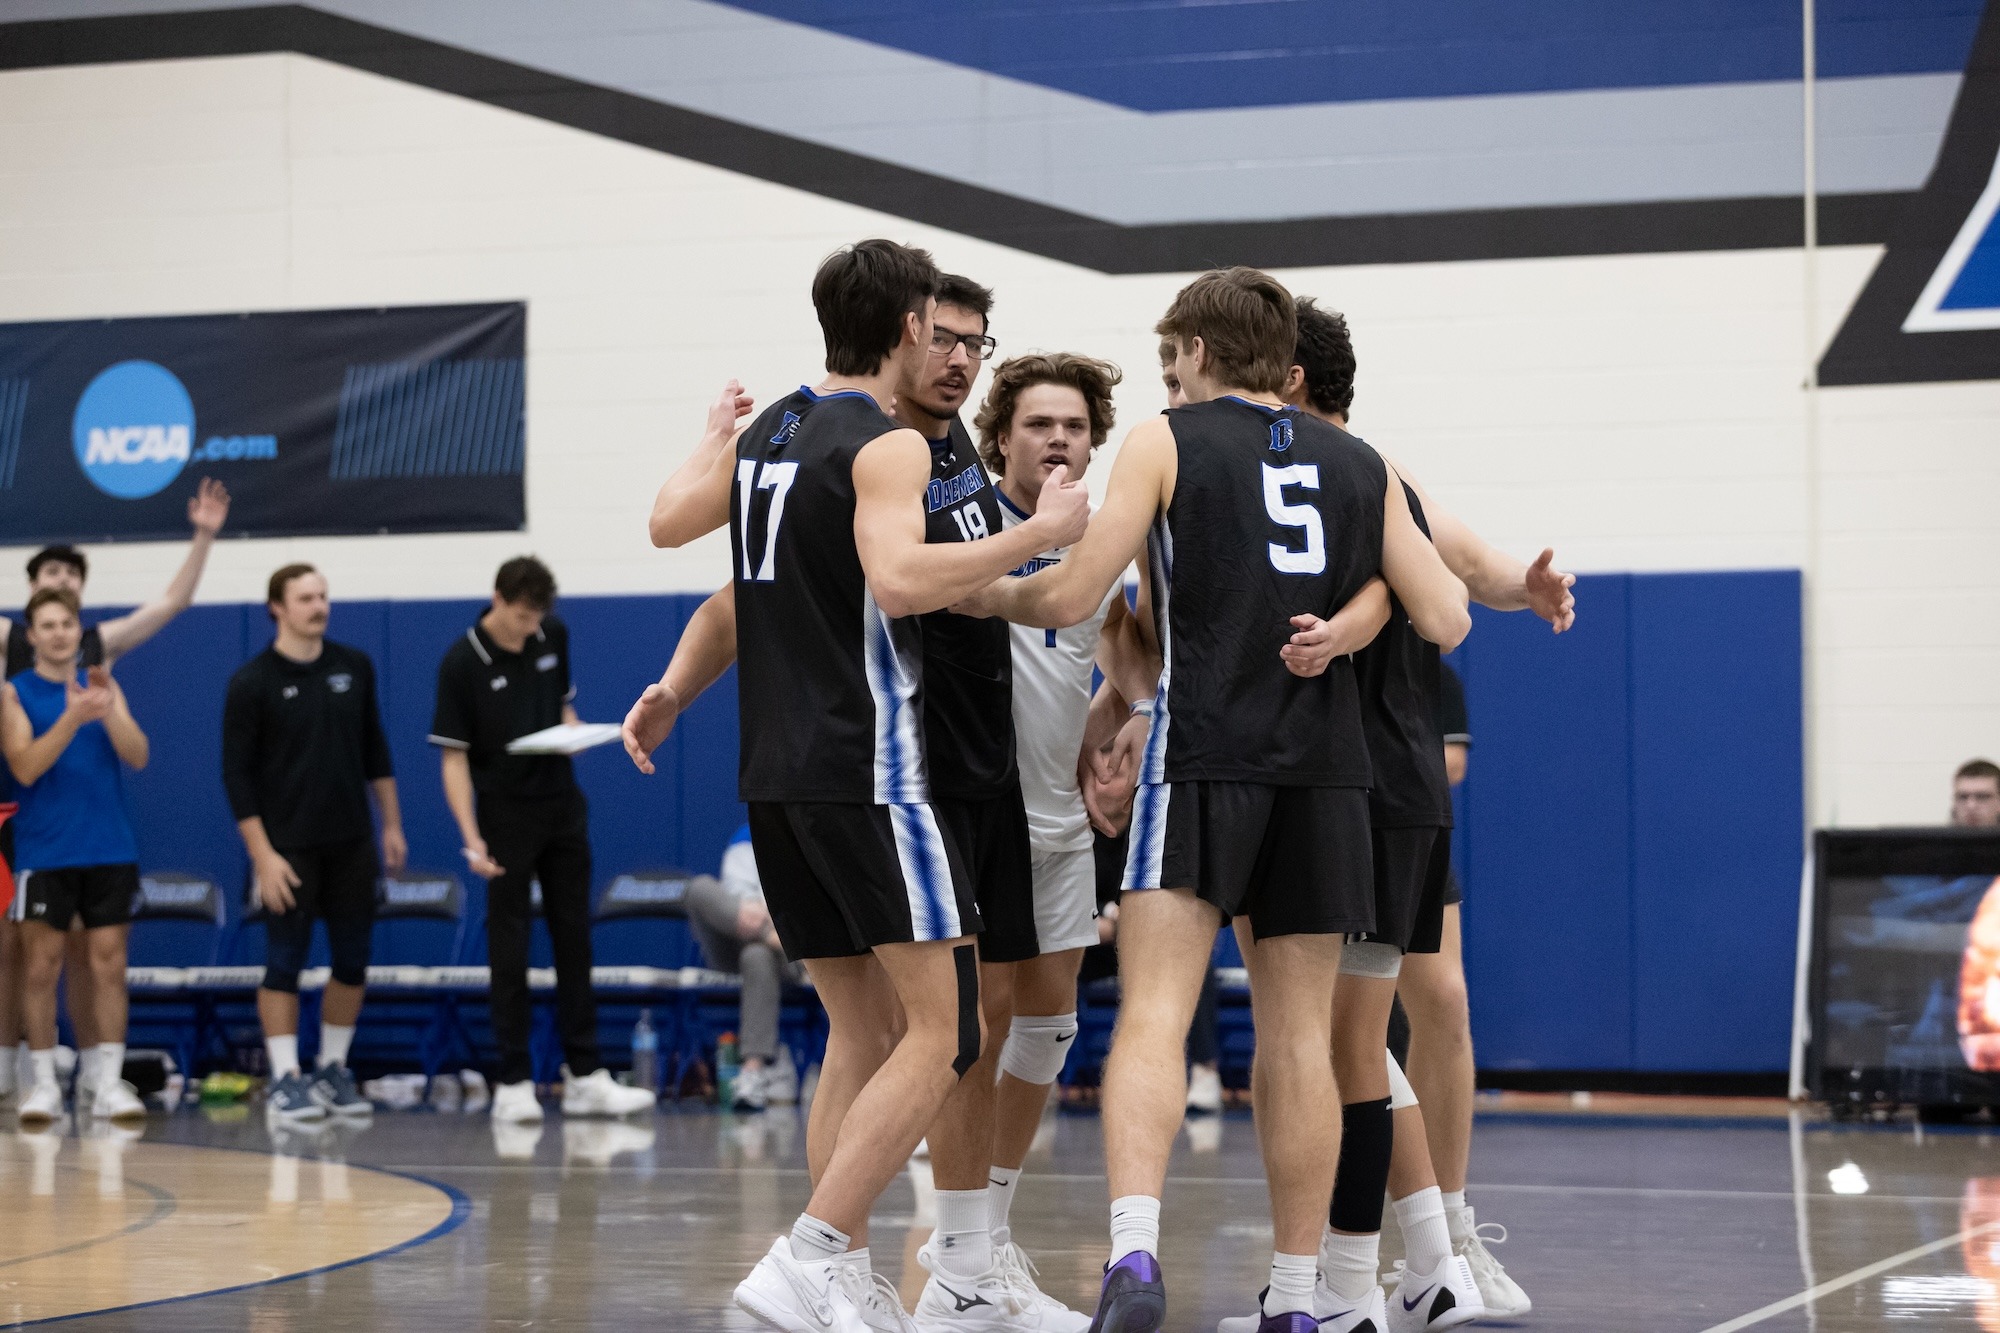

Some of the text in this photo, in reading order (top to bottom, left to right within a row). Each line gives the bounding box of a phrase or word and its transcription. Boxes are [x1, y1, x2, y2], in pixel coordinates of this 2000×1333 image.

[737, 458, 800, 582] 17
[951, 500, 990, 542] 18
[1261, 461, 1327, 576] 5
